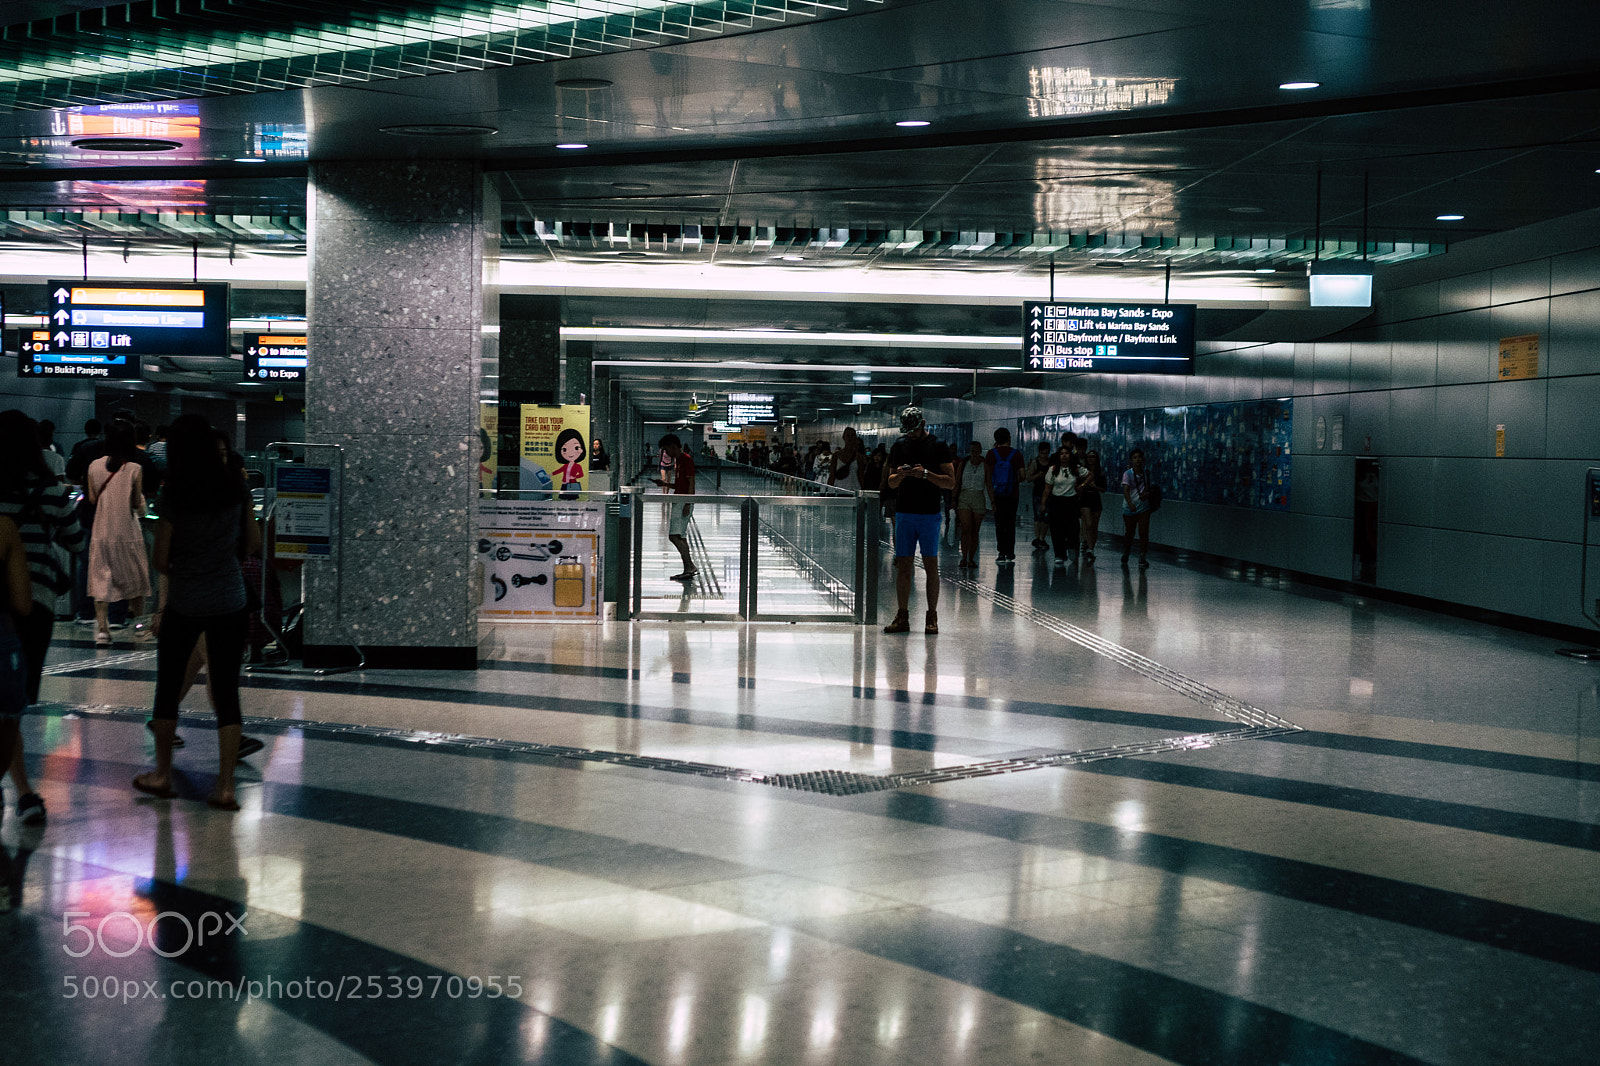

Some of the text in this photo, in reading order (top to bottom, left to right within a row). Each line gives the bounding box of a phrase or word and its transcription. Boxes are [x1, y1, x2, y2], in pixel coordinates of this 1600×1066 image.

[1068, 307, 1098, 316] Marina
[1101, 308, 1117, 318] Bay
[1119, 308, 1144, 318] Sands
[1152, 309, 1173, 319] Expo
[1080, 320, 1094, 330] Lift
[1108, 322, 1132, 330] Marina
[1134, 323, 1147, 332] Bay
[1148, 323, 1169, 331] Sands
[111, 334, 132, 346] Lift
[1068, 334, 1101, 343] Bayfront
[1103, 334, 1118, 342] Ave
[1124, 335, 1158, 344] Bayfront
[1160, 335, 1177, 344] Link
[270, 346, 308, 356] to Marina
[1056, 346, 1072, 354] Bus
[1074, 346, 1093, 356] stop
[1098, 346, 1104, 354] 3
[1068, 359, 1092, 368] Toilet
[76, 366, 108, 376] Panjang
[280, 370, 299, 379] Expo
